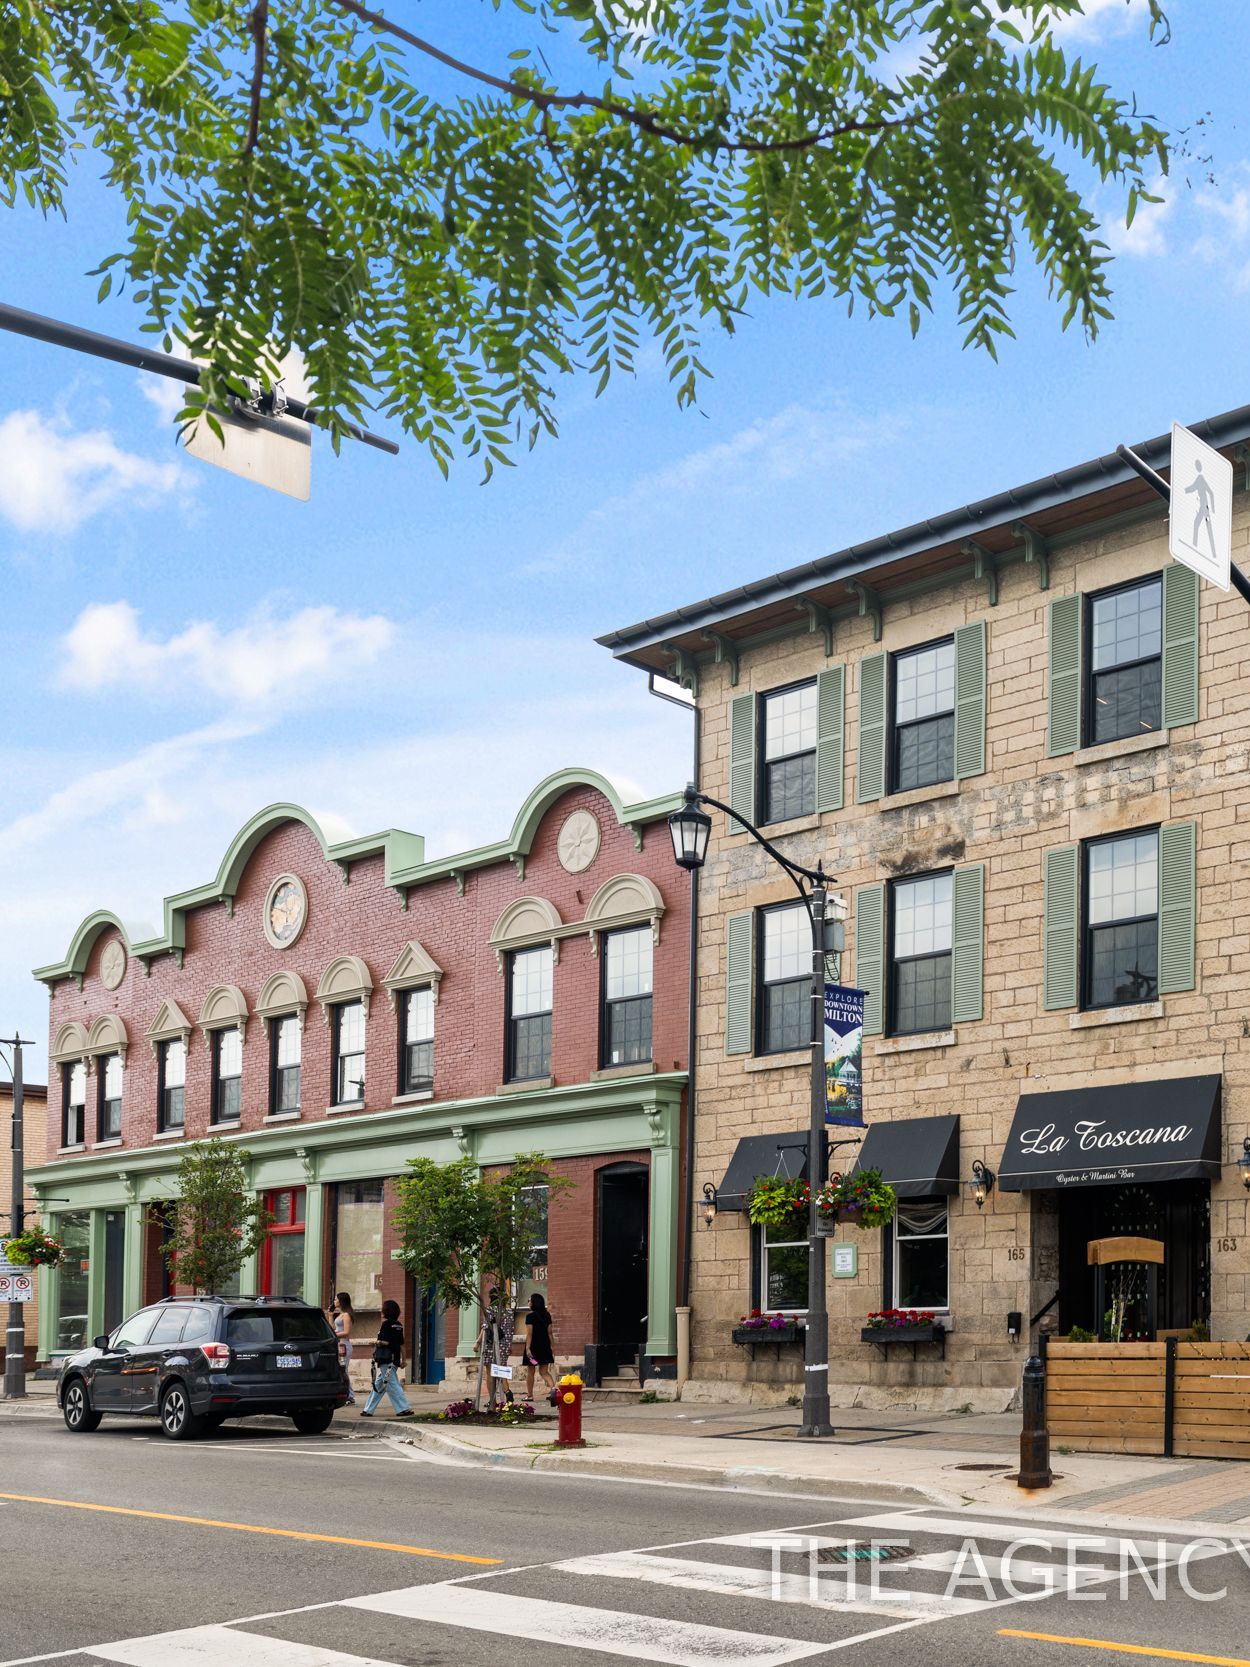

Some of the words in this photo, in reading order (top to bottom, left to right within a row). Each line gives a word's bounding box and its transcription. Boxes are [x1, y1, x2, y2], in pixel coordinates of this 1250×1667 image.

[824, 991, 863, 1005] EXPLORE
[824, 1000, 863, 1013] DOWNTOWN
[823, 1008, 863, 1025] MILTON
[1020, 1123, 1069, 1154] La
[1074, 1120, 1192, 1151] Toscana
[1056, 1173, 1080, 1185] Oyster
[1081, 1172, 1088, 1181] &
[1089, 1170, 1117, 1180] Martini
[1118, 1168, 1135, 1179] Bar
[1217, 1238, 1237, 1253] 163
[1008, 1248, 1025, 1261] 165
